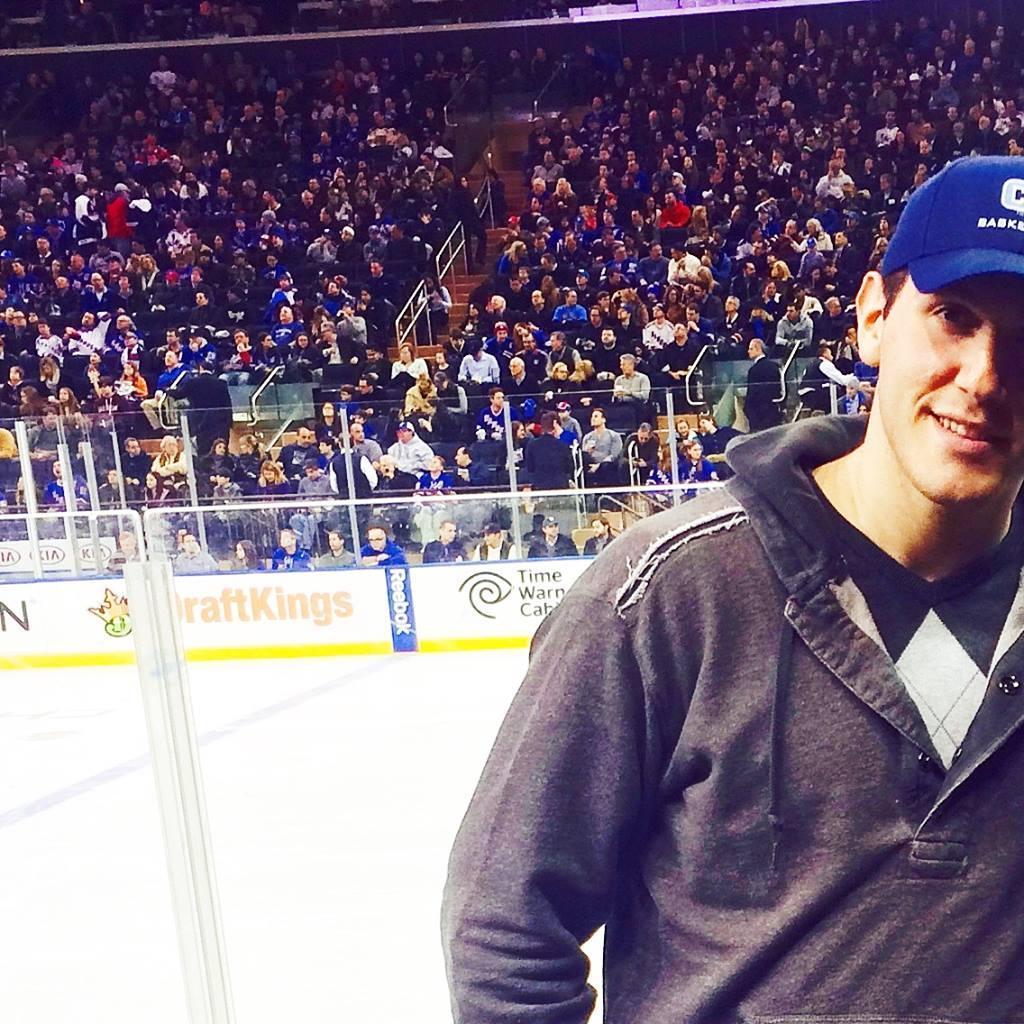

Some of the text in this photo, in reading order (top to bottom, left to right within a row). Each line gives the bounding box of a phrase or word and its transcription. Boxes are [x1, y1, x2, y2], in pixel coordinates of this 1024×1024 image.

[517, 569, 562, 583] Time
[518, 586, 565, 600] Warn
[389, 568, 412, 636] Reebok
